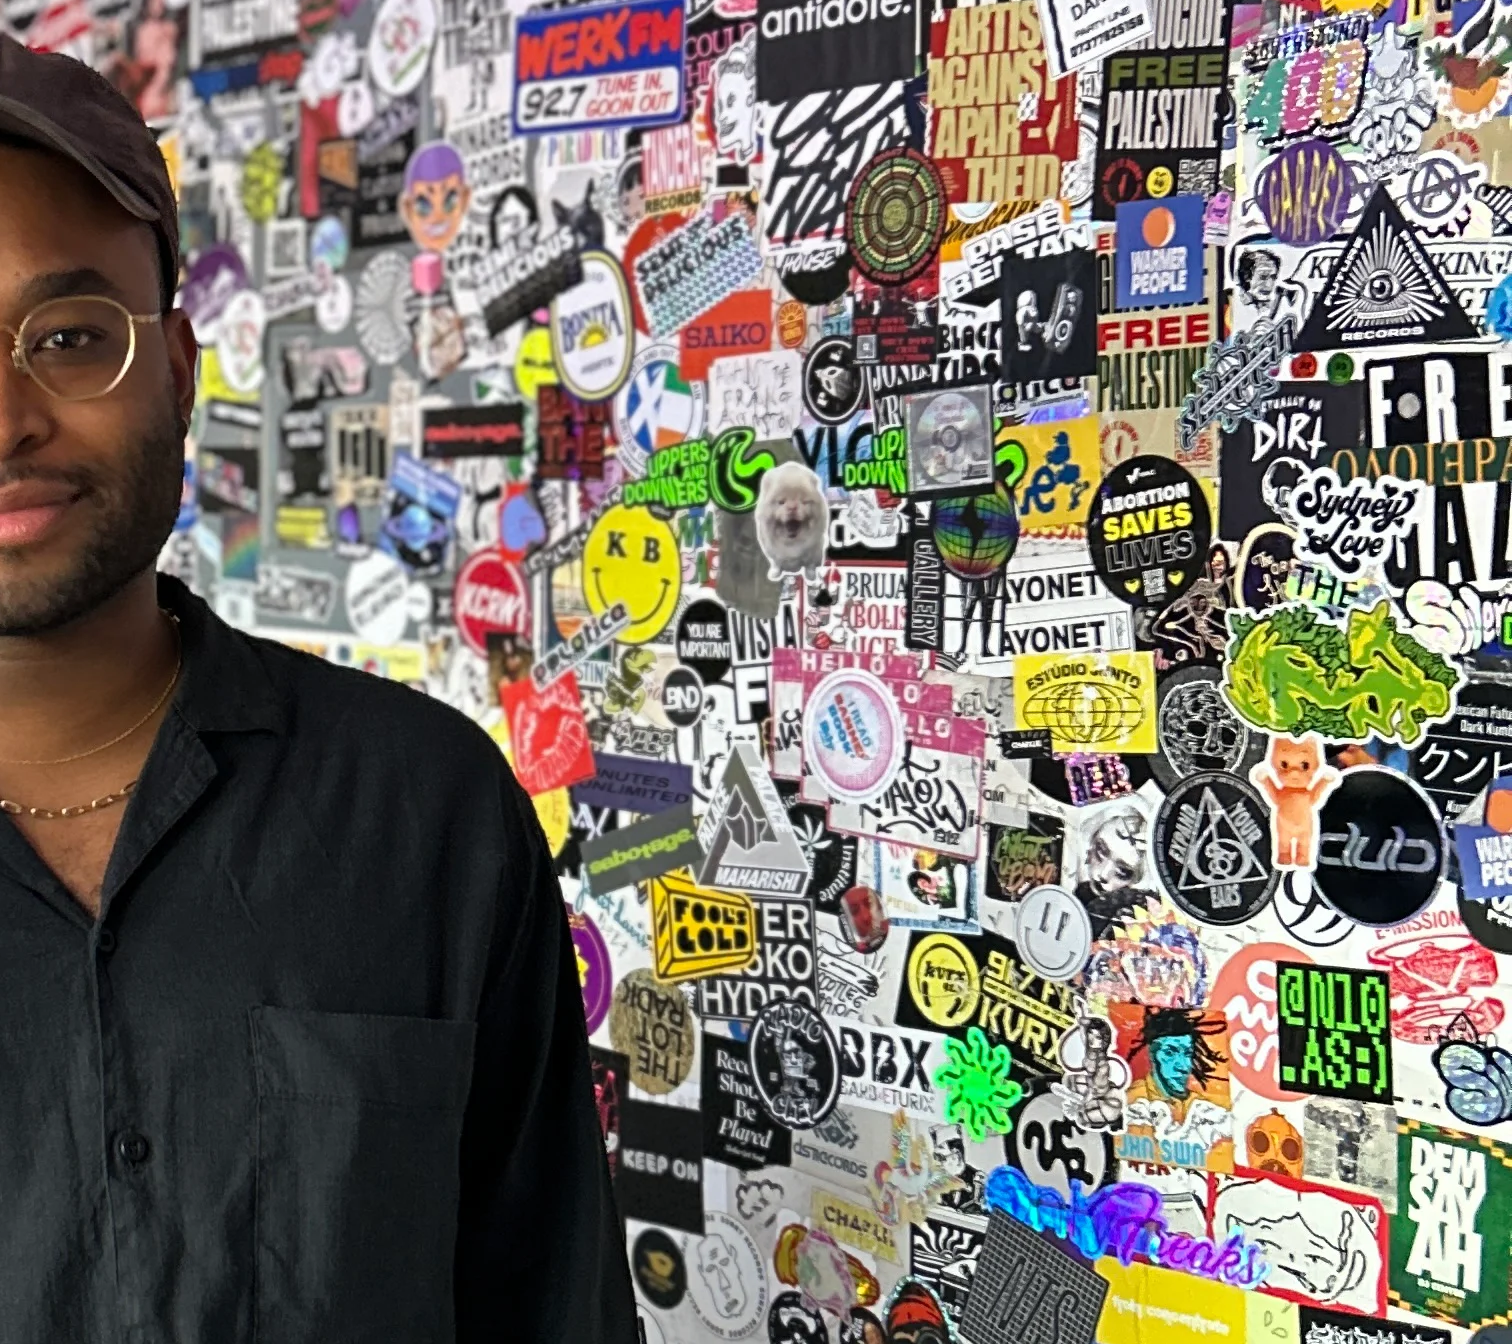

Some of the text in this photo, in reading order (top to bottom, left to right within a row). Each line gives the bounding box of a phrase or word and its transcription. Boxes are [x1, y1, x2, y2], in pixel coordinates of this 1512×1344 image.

[518, 7, 684, 75] WERK FM
[593, 76, 639, 97] TUNE
[1109, 56, 1223, 86] FREE
[523, 81, 586, 120] 92.7
[632, 91, 672, 113] OUT
[1106, 87, 1220, 151] PALESTINE
[1131, 248, 1188, 272] WARMER
[1130, 271, 1188, 296] PEOPLE
[559, 300, 622, 352] BONITA
[686, 320, 768, 349] SAIKO
[1098, 313, 1211, 350] FREE
[1341, 326, 1425, 341] RECORDS
[646, 439, 709, 475] UPPERS
[681, 462, 708, 484] AND
[624, 471, 709, 508] DOWNERS
[1102, 482, 1189, 515] ABORTION
[1296, 480, 1415, 527] Sydney
[1104, 503, 1194, 542] SAVES
[607, 531, 661, 564] K B
[1105, 530, 1196, 573] LIVES
[1307, 521, 1385, 572] Love
[462, 583, 523, 620] KCRW
[911, 537, 940, 646] GALLERY
[1299, 566, 1360, 607] THE
[681, 641, 731, 658] IMPORTANT
[687, 623, 722, 640] YOU ARE
[750, 763, 788, 834] PALACE
[699, 786, 731, 852] PALACE
[1169, 804, 1197, 863] EXPAND
[1231, 801, 1263, 846] YOUR
[590, 829, 695, 875] sabotage.
[715, 866, 800, 891] MAHARISHI
[735, 1097, 756, 1123] Be
[719, 1117, 773, 1150] Played
[622, 1148, 701, 1181] KEEP ON
[1410, 1136, 1486, 1191] DEM
[1408, 1176, 1486, 1237] SAY
[1406, 1221, 1482, 1292] AH
